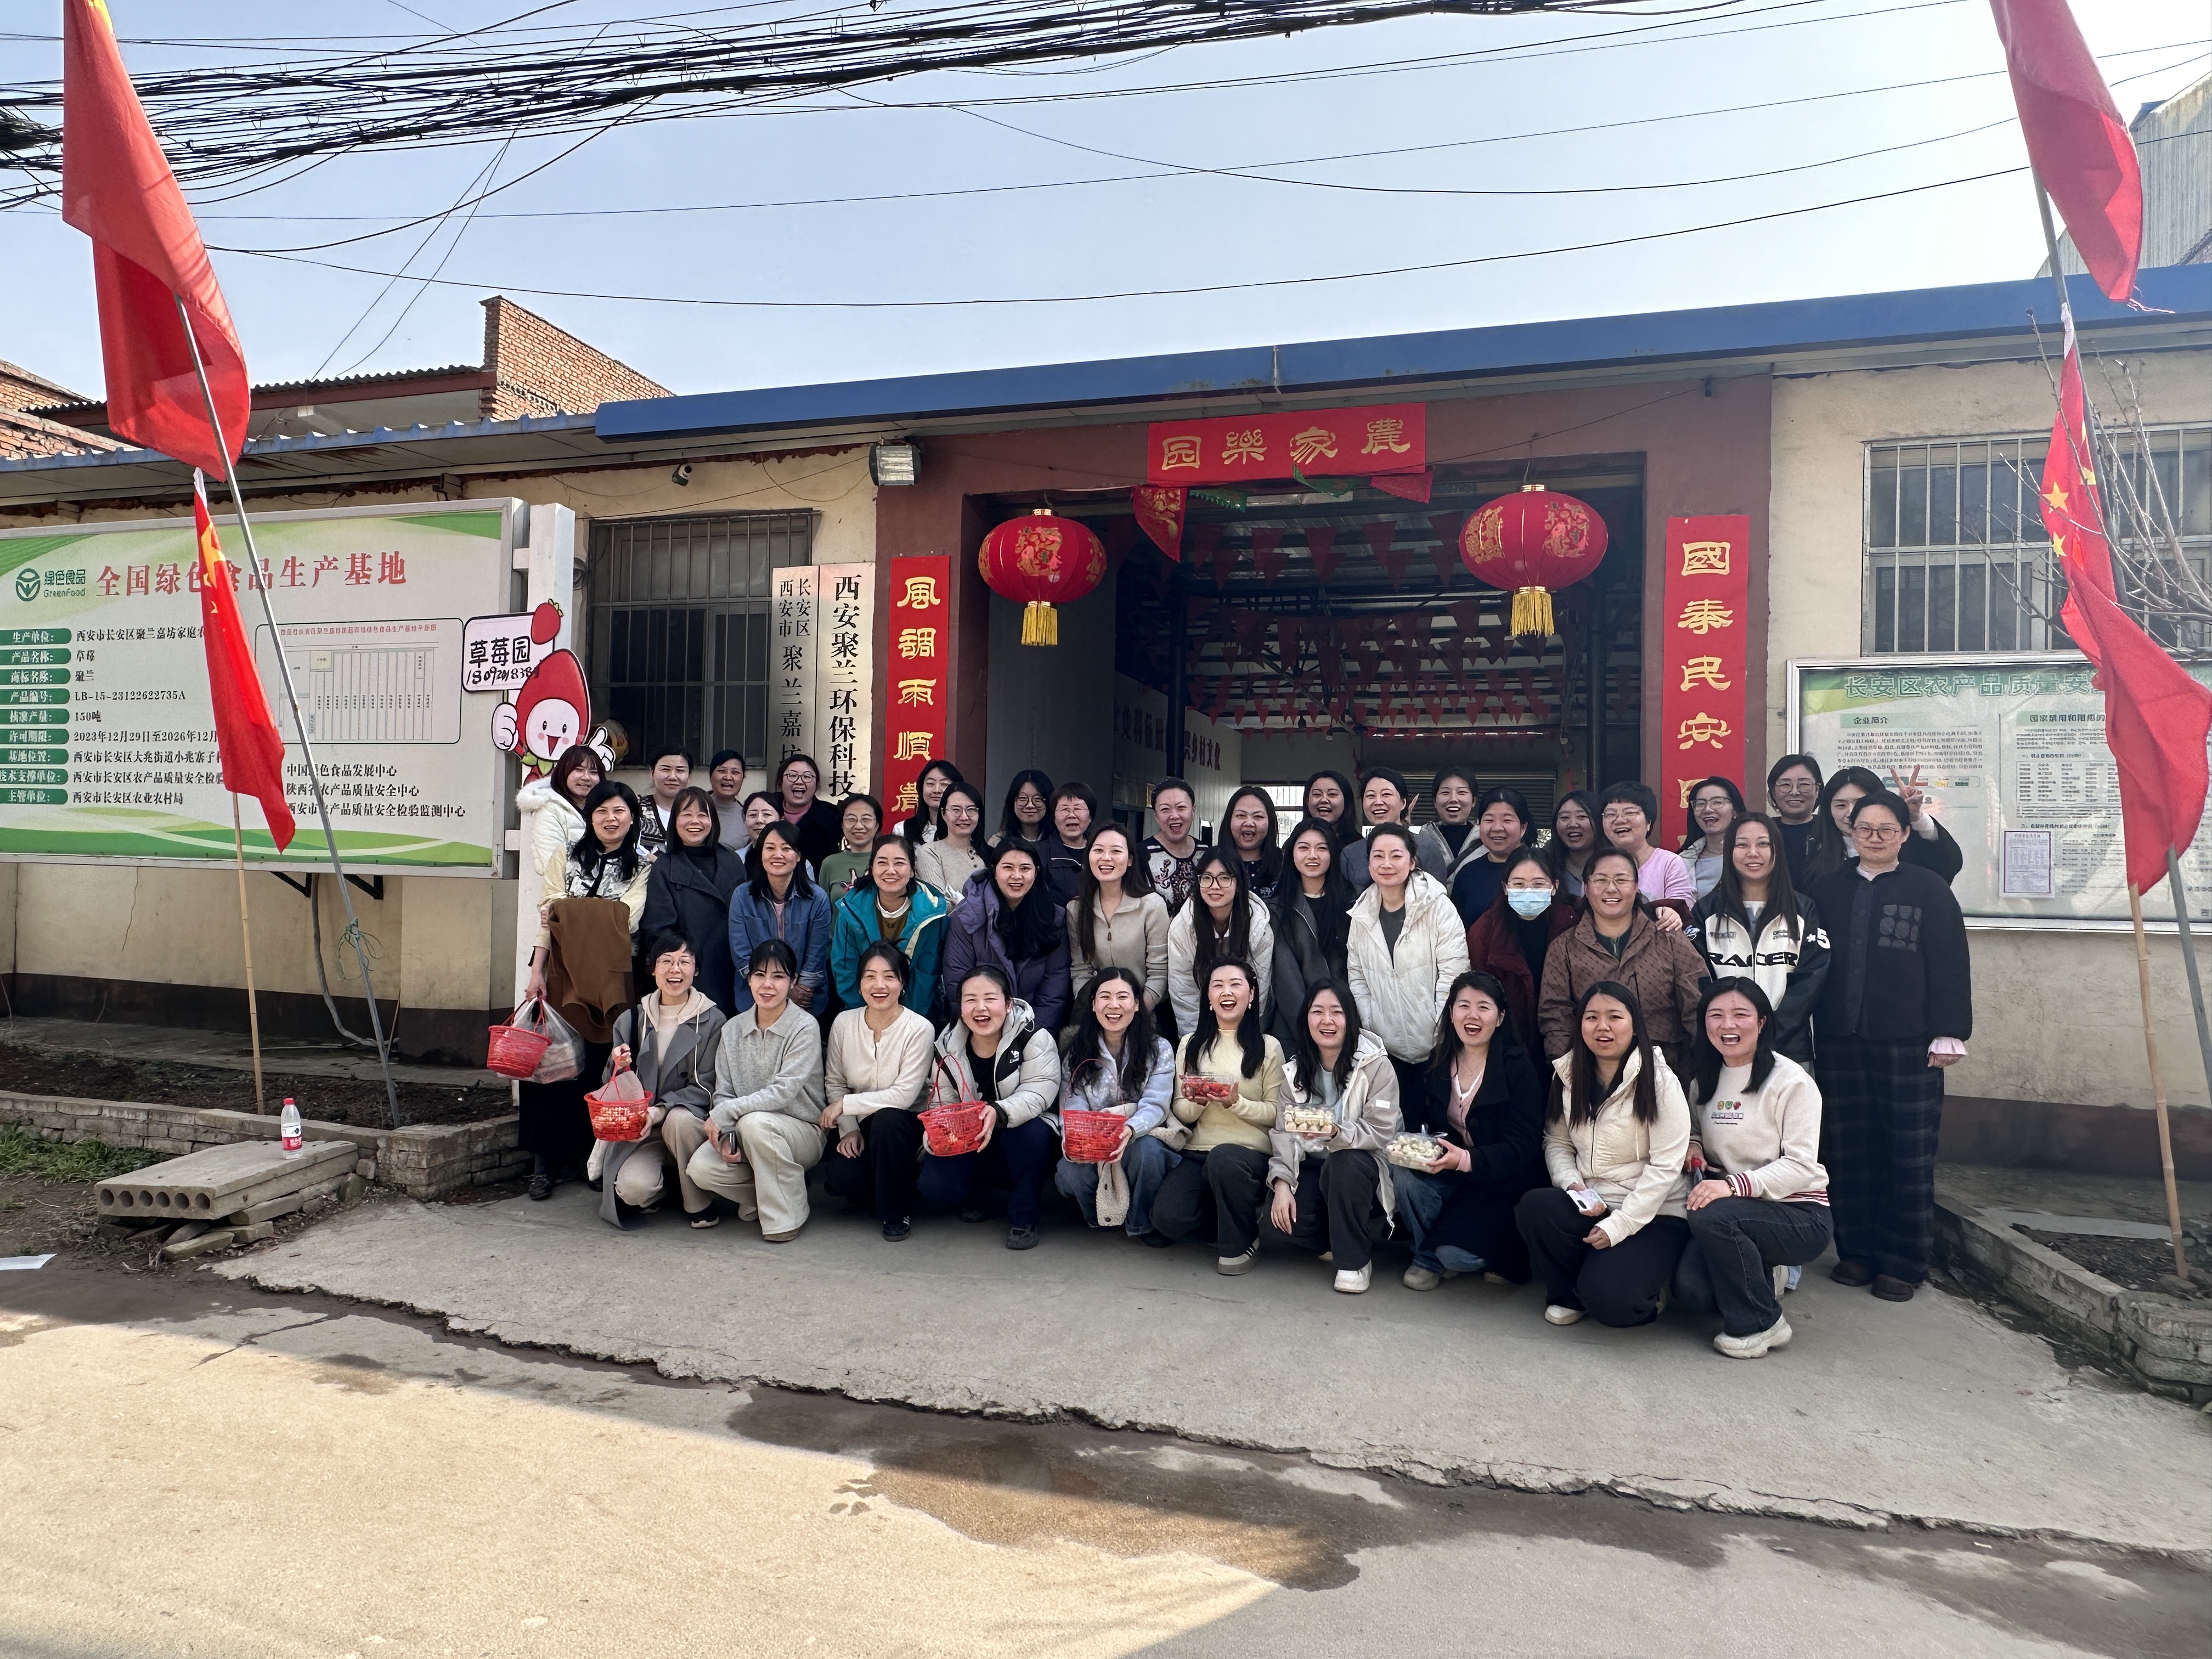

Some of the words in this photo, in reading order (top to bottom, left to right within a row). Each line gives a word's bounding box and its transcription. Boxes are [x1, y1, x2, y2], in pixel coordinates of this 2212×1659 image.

[44, 569, 86, 585] 绿色食品
[778, 579, 793, 637] 西安市
[796, 578, 811, 636] 长安区
[469, 636, 531, 668] 草莓园
[828, 574, 861, 798] 西安聚兰环保科技
[1844, 672, 2106, 698] 长安区农产品质量安
[75, 710, 101, 723] 150吨
[1854, 716, 1888, 725] 企业简介
[287, 763, 397, 777] 中国色食品发展中心
